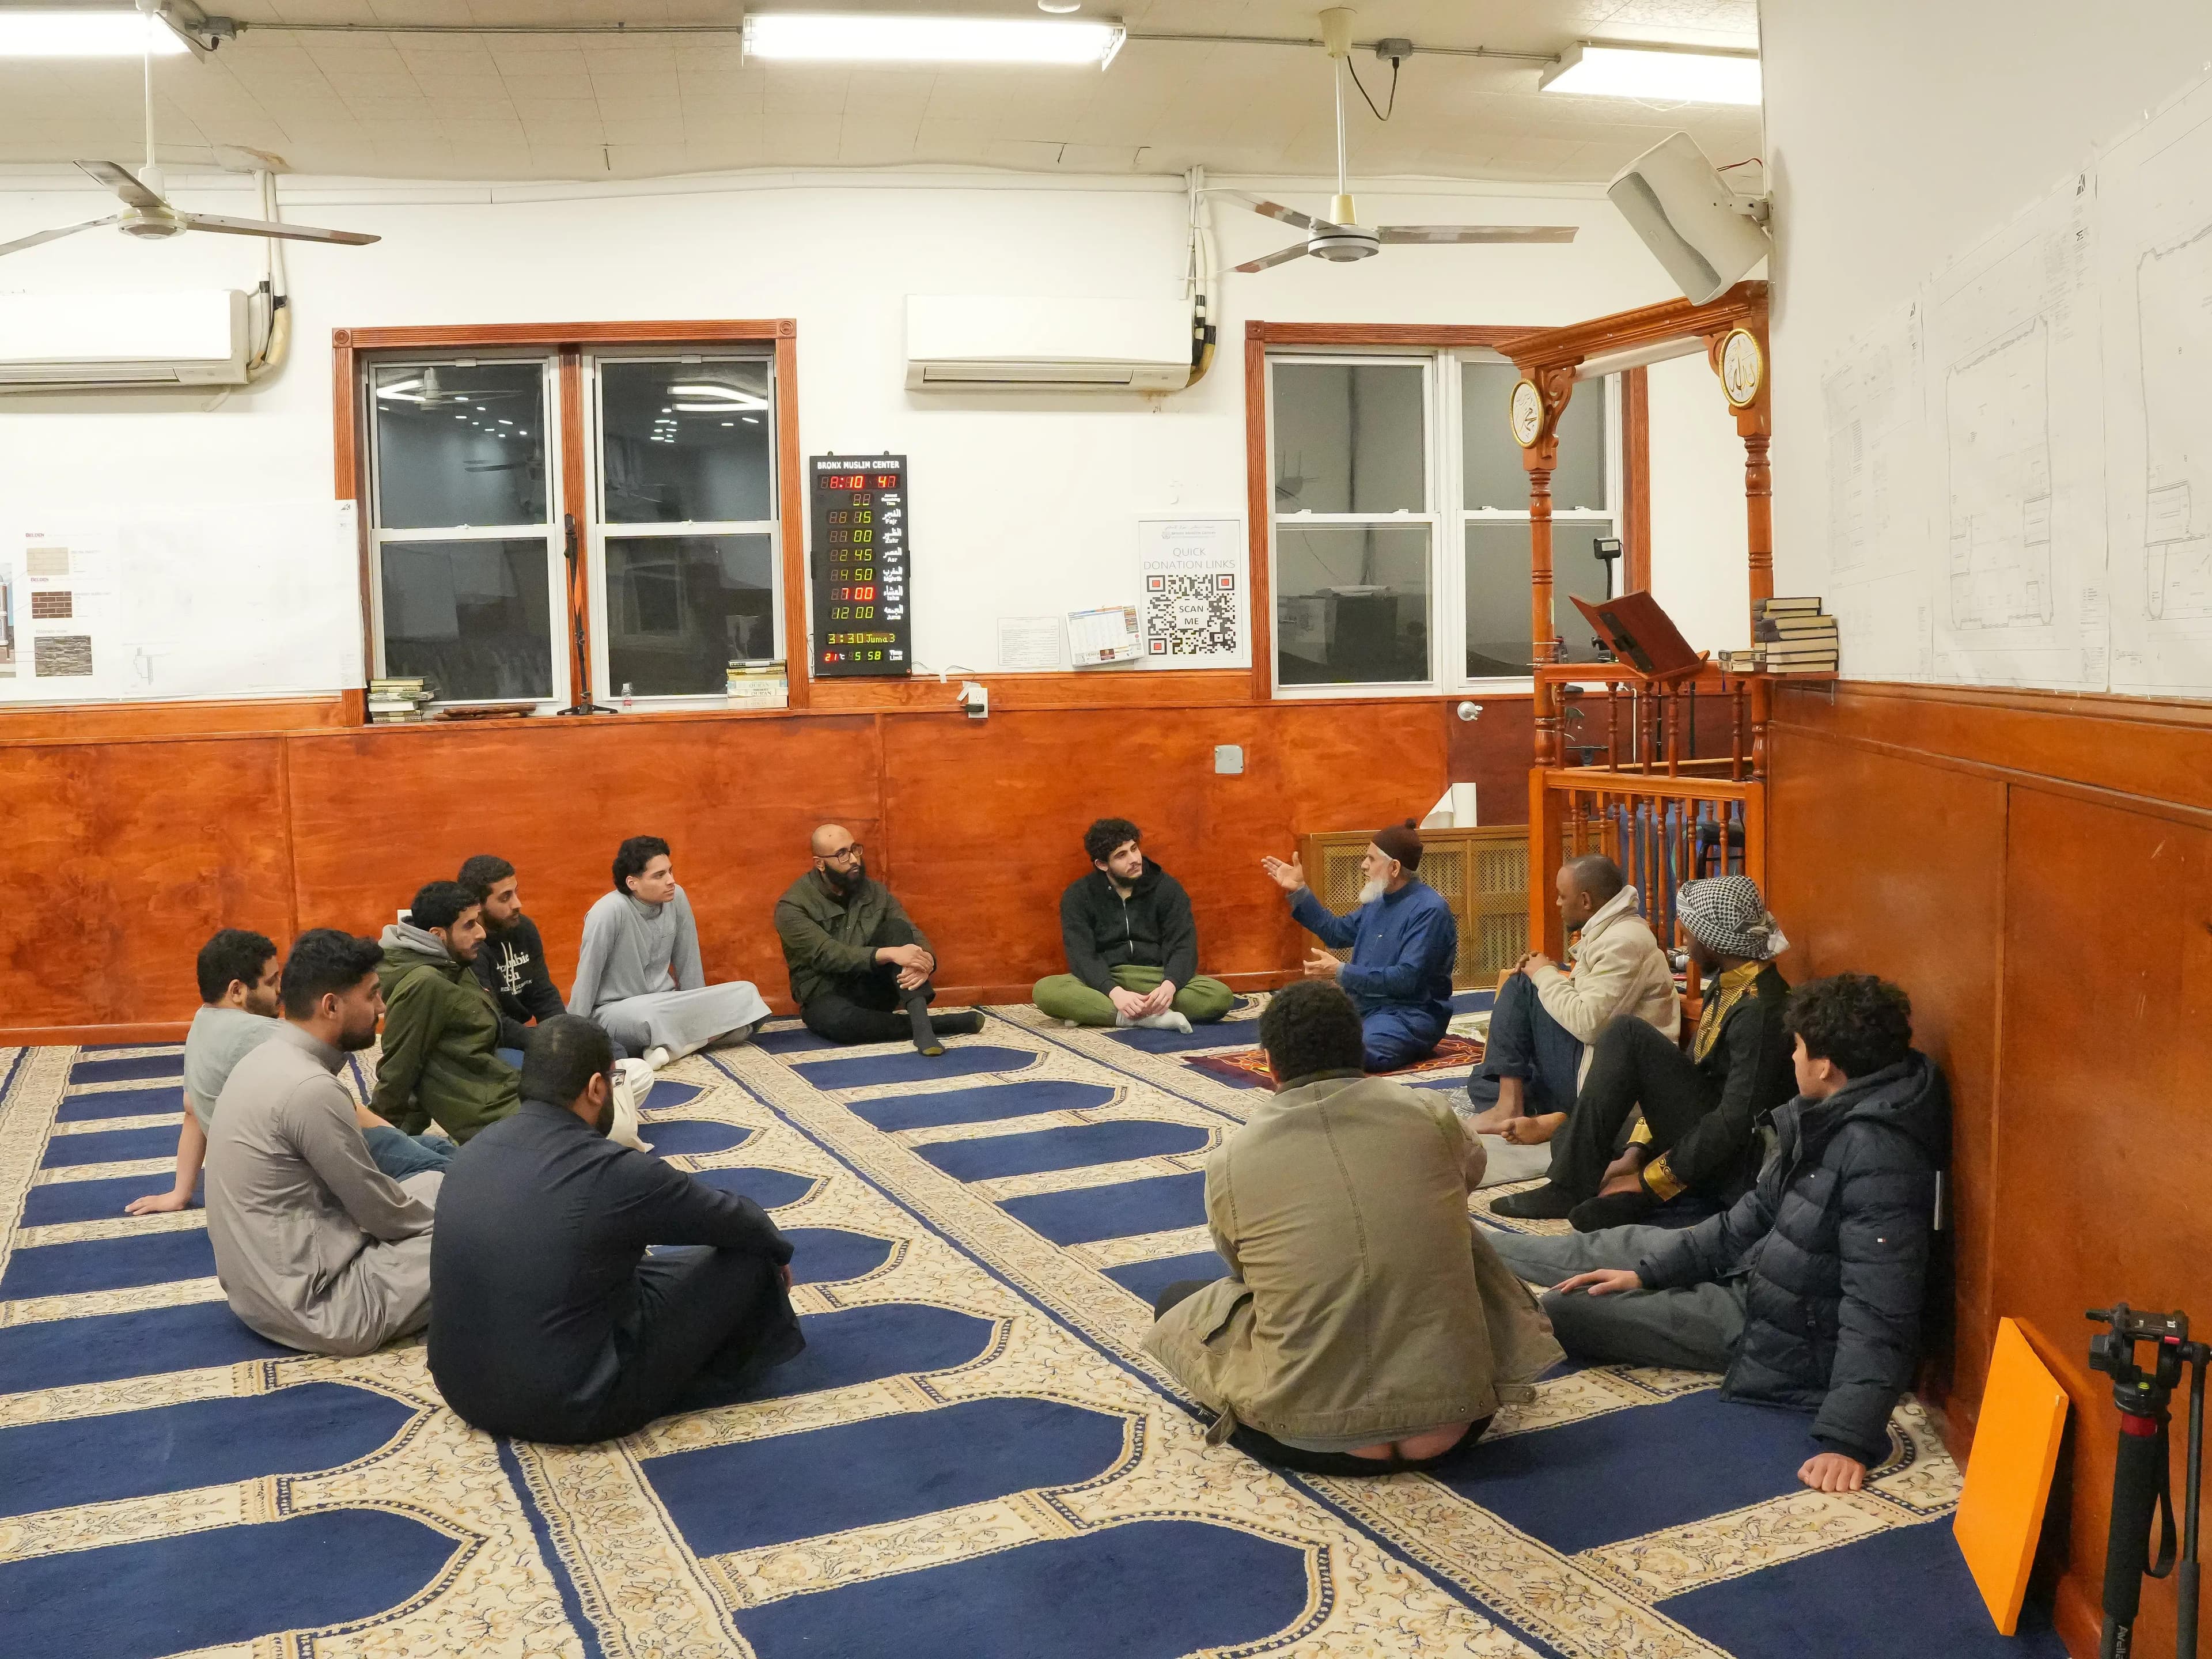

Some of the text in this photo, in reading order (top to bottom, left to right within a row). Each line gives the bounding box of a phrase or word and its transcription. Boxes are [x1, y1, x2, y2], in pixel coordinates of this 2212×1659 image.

[817, 461, 842, 469] BRONX
[873, 461, 900, 469] CENTER
[830, 476, 896, 488] 8:10 47
[1173, 547, 1206, 557] QUICK
[1144, 560, 1236, 570] DONATION LINKS
[855, 568, 873, 581] 50
[854, 587, 873, 600] 00
[855, 607, 874, 619] 00
